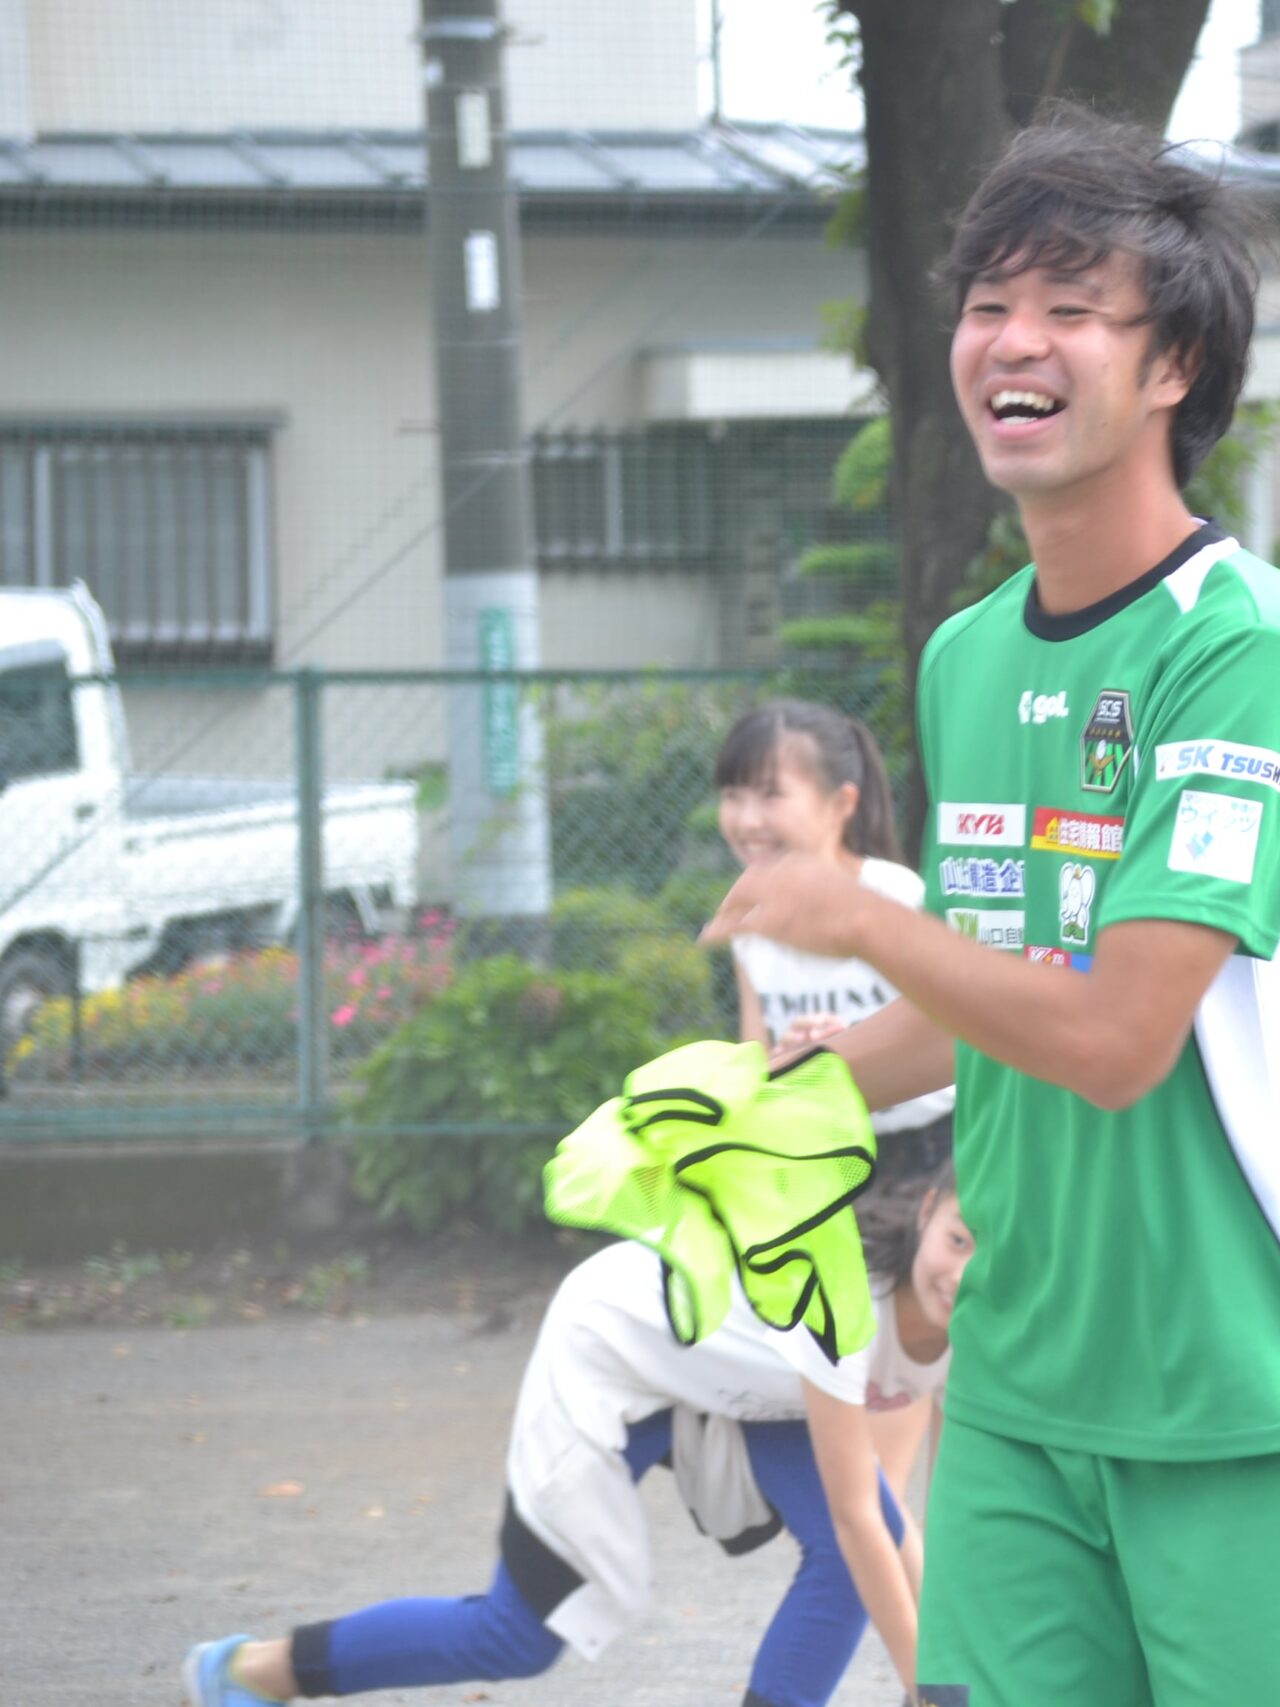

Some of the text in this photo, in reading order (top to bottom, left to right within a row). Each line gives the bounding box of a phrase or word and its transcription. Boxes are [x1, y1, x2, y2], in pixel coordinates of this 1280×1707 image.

[1096, 698, 1123, 718] SCS
[1177, 745, 1214, 770] SK
[957, 813, 1005, 836] KYB
